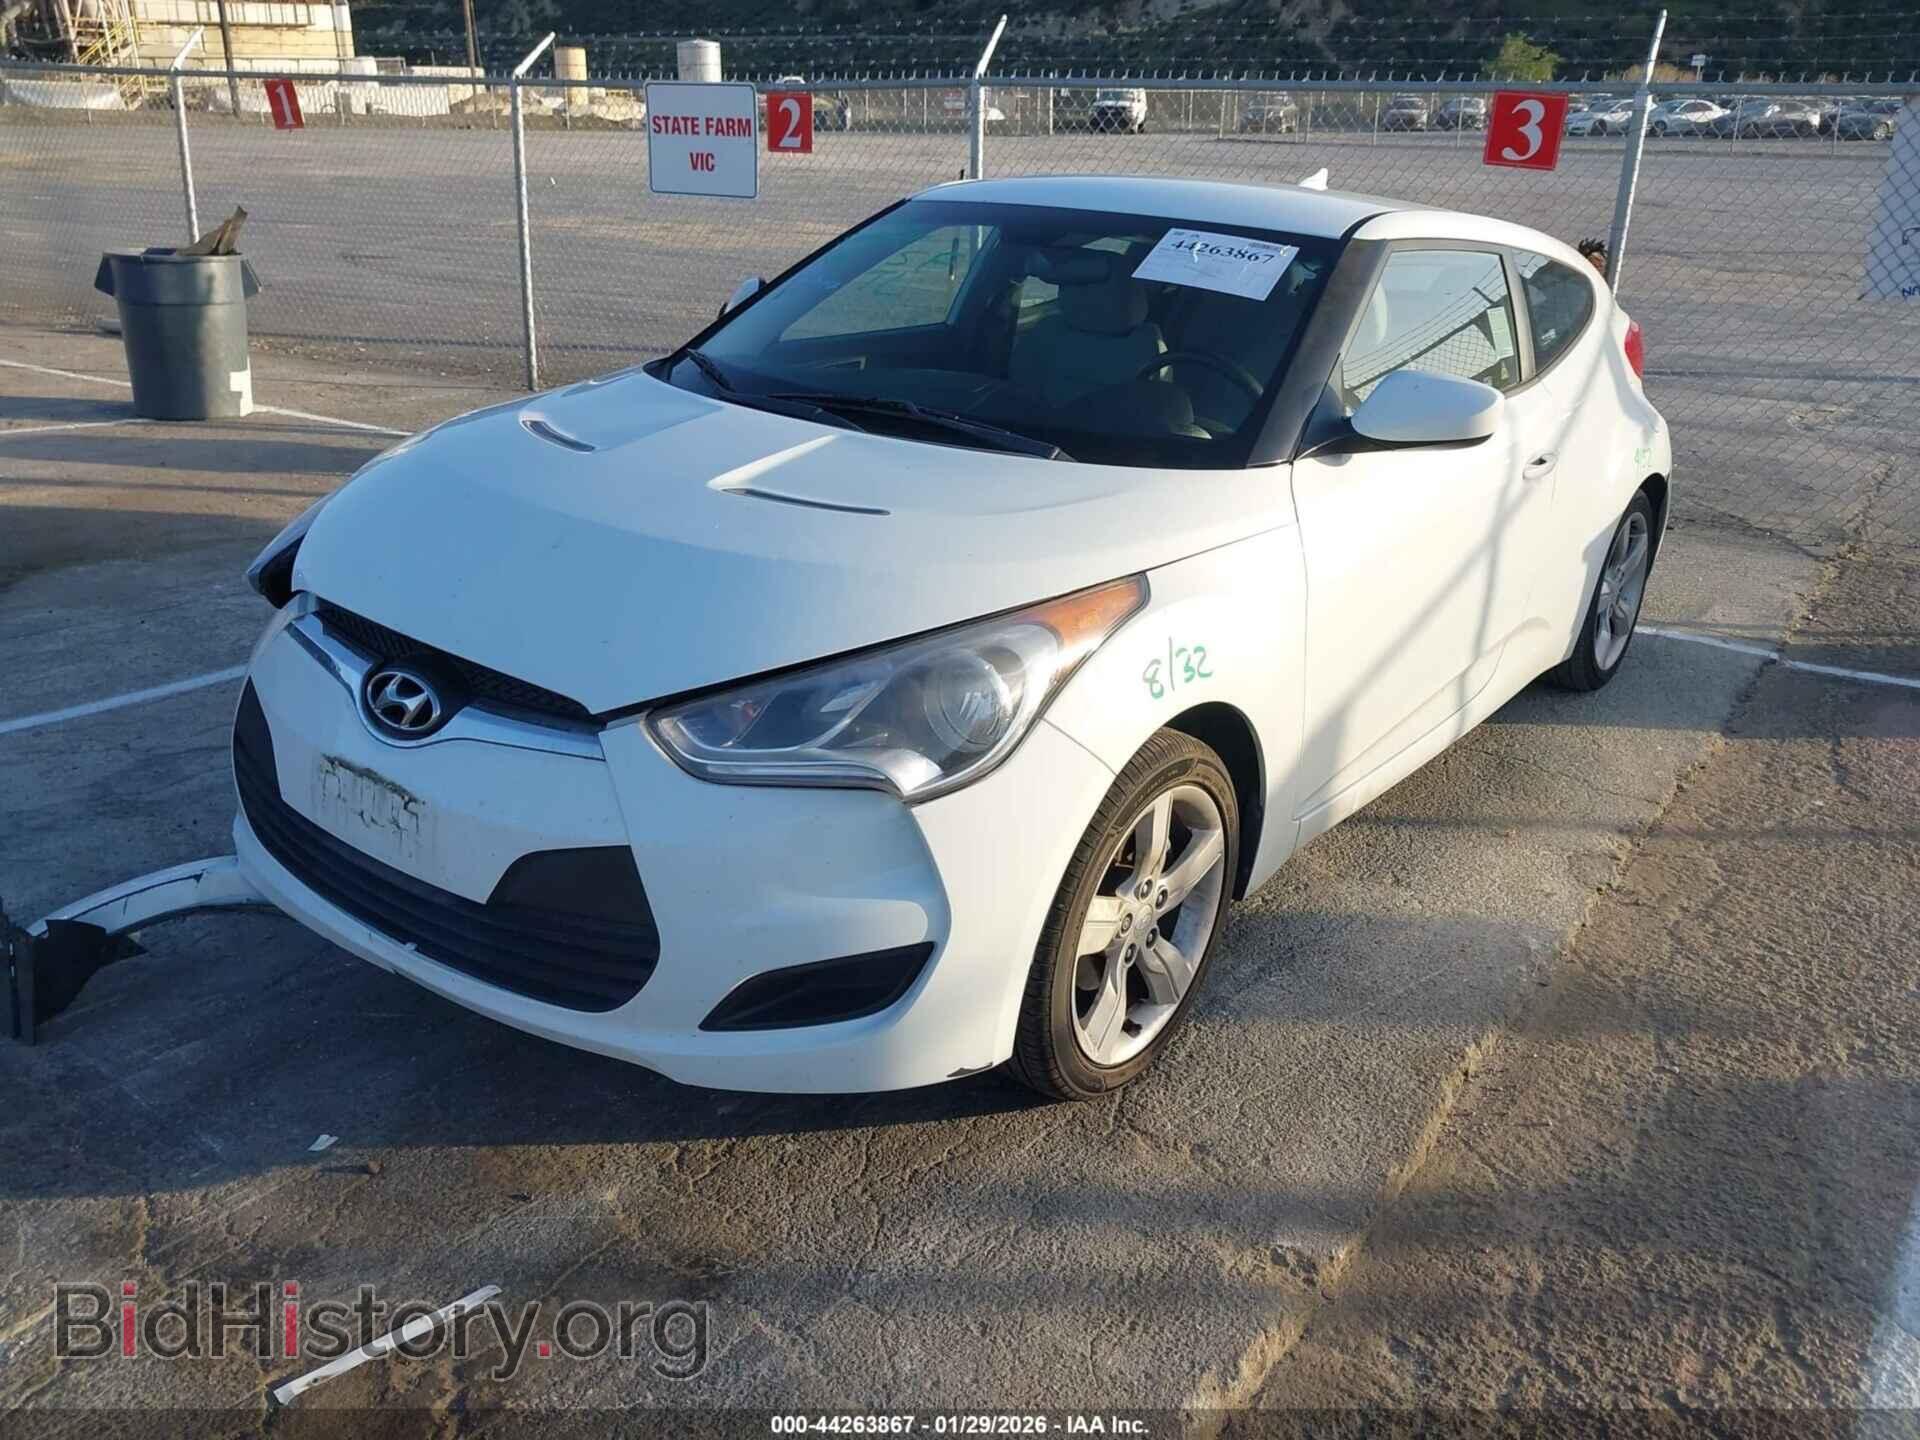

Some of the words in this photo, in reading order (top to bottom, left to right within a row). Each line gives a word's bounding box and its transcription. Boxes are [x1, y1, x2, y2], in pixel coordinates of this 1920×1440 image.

[275, 84, 297, 125] 1
[652, 115, 700, 136] STATE
[705, 117, 752, 138] FARM
[778, 98, 803, 148] 2
[1502, 99, 1545, 161] 3
[689, 151, 716, 172] VIC
[1170, 239, 1275, 265] 44263867
